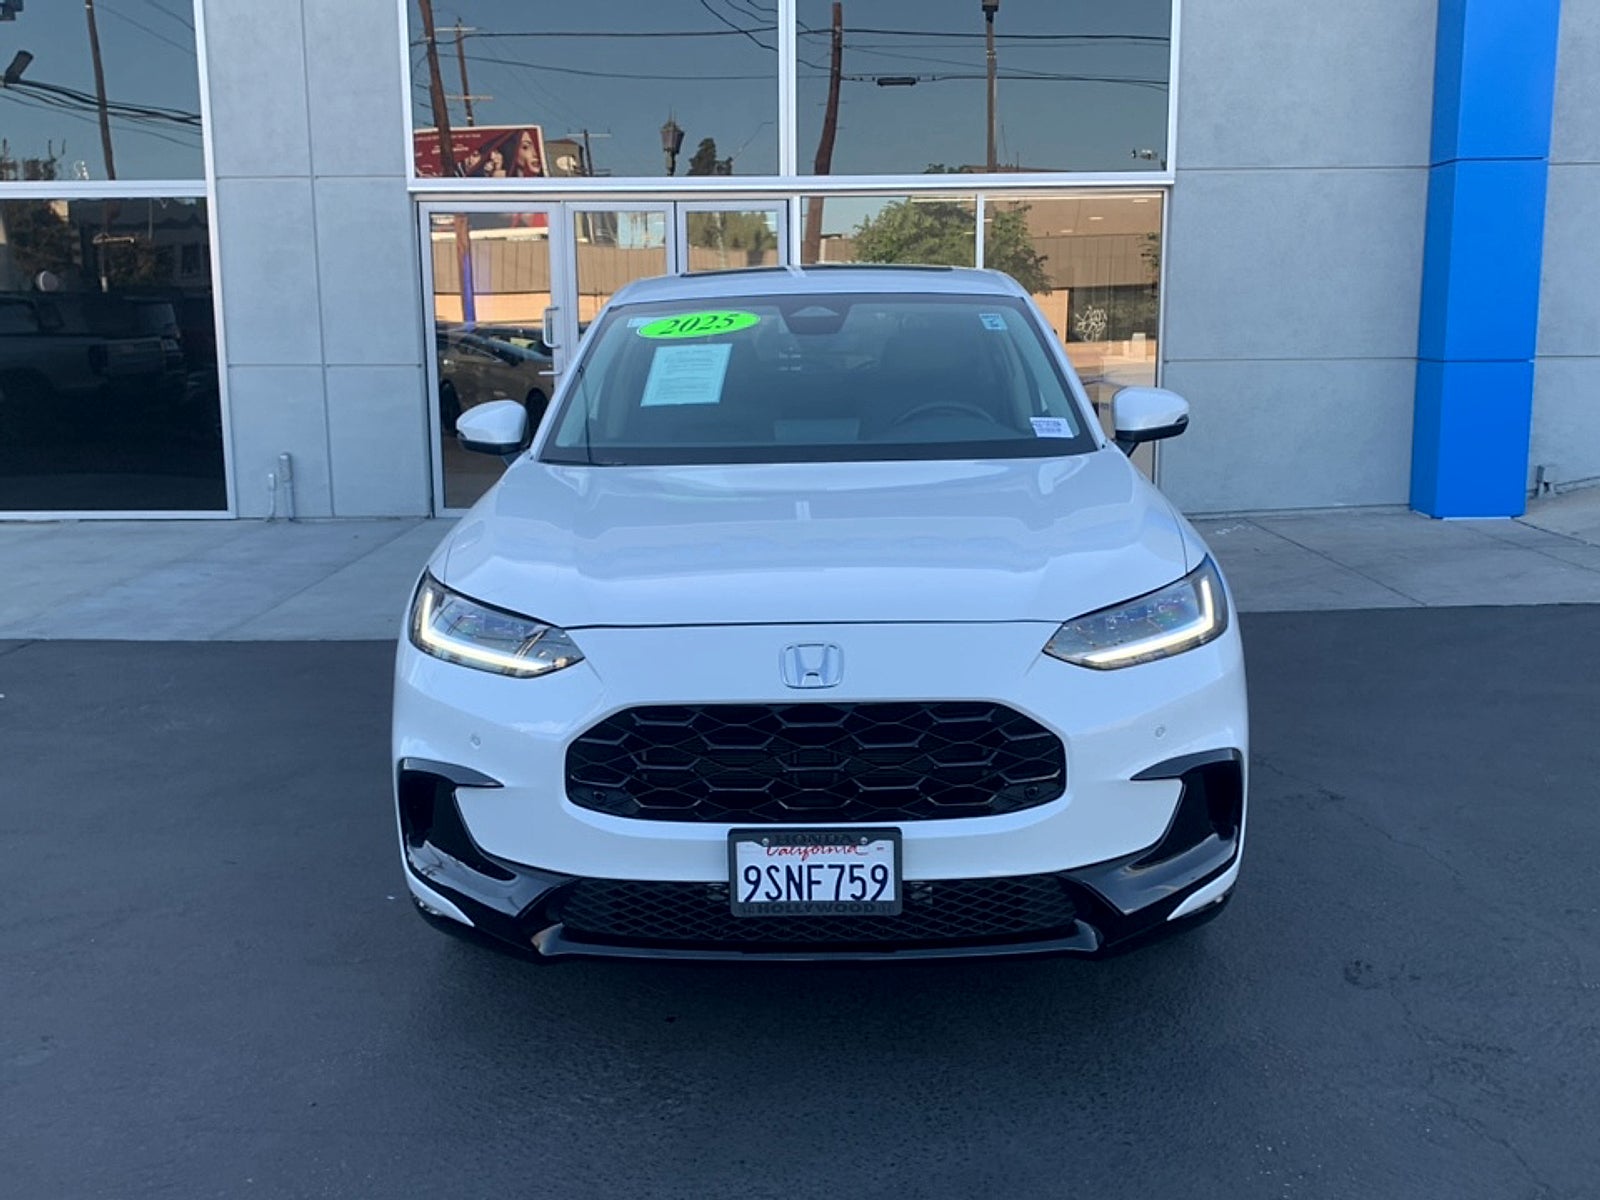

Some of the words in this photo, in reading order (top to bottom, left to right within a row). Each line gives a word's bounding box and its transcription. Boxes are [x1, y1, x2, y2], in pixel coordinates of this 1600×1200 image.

[658, 313, 740, 335] 2025
[775, 833, 852, 845] HONDA
[743, 864, 889, 901] 9SNF759
[757, 903, 877, 914] HOLLYWOOD
